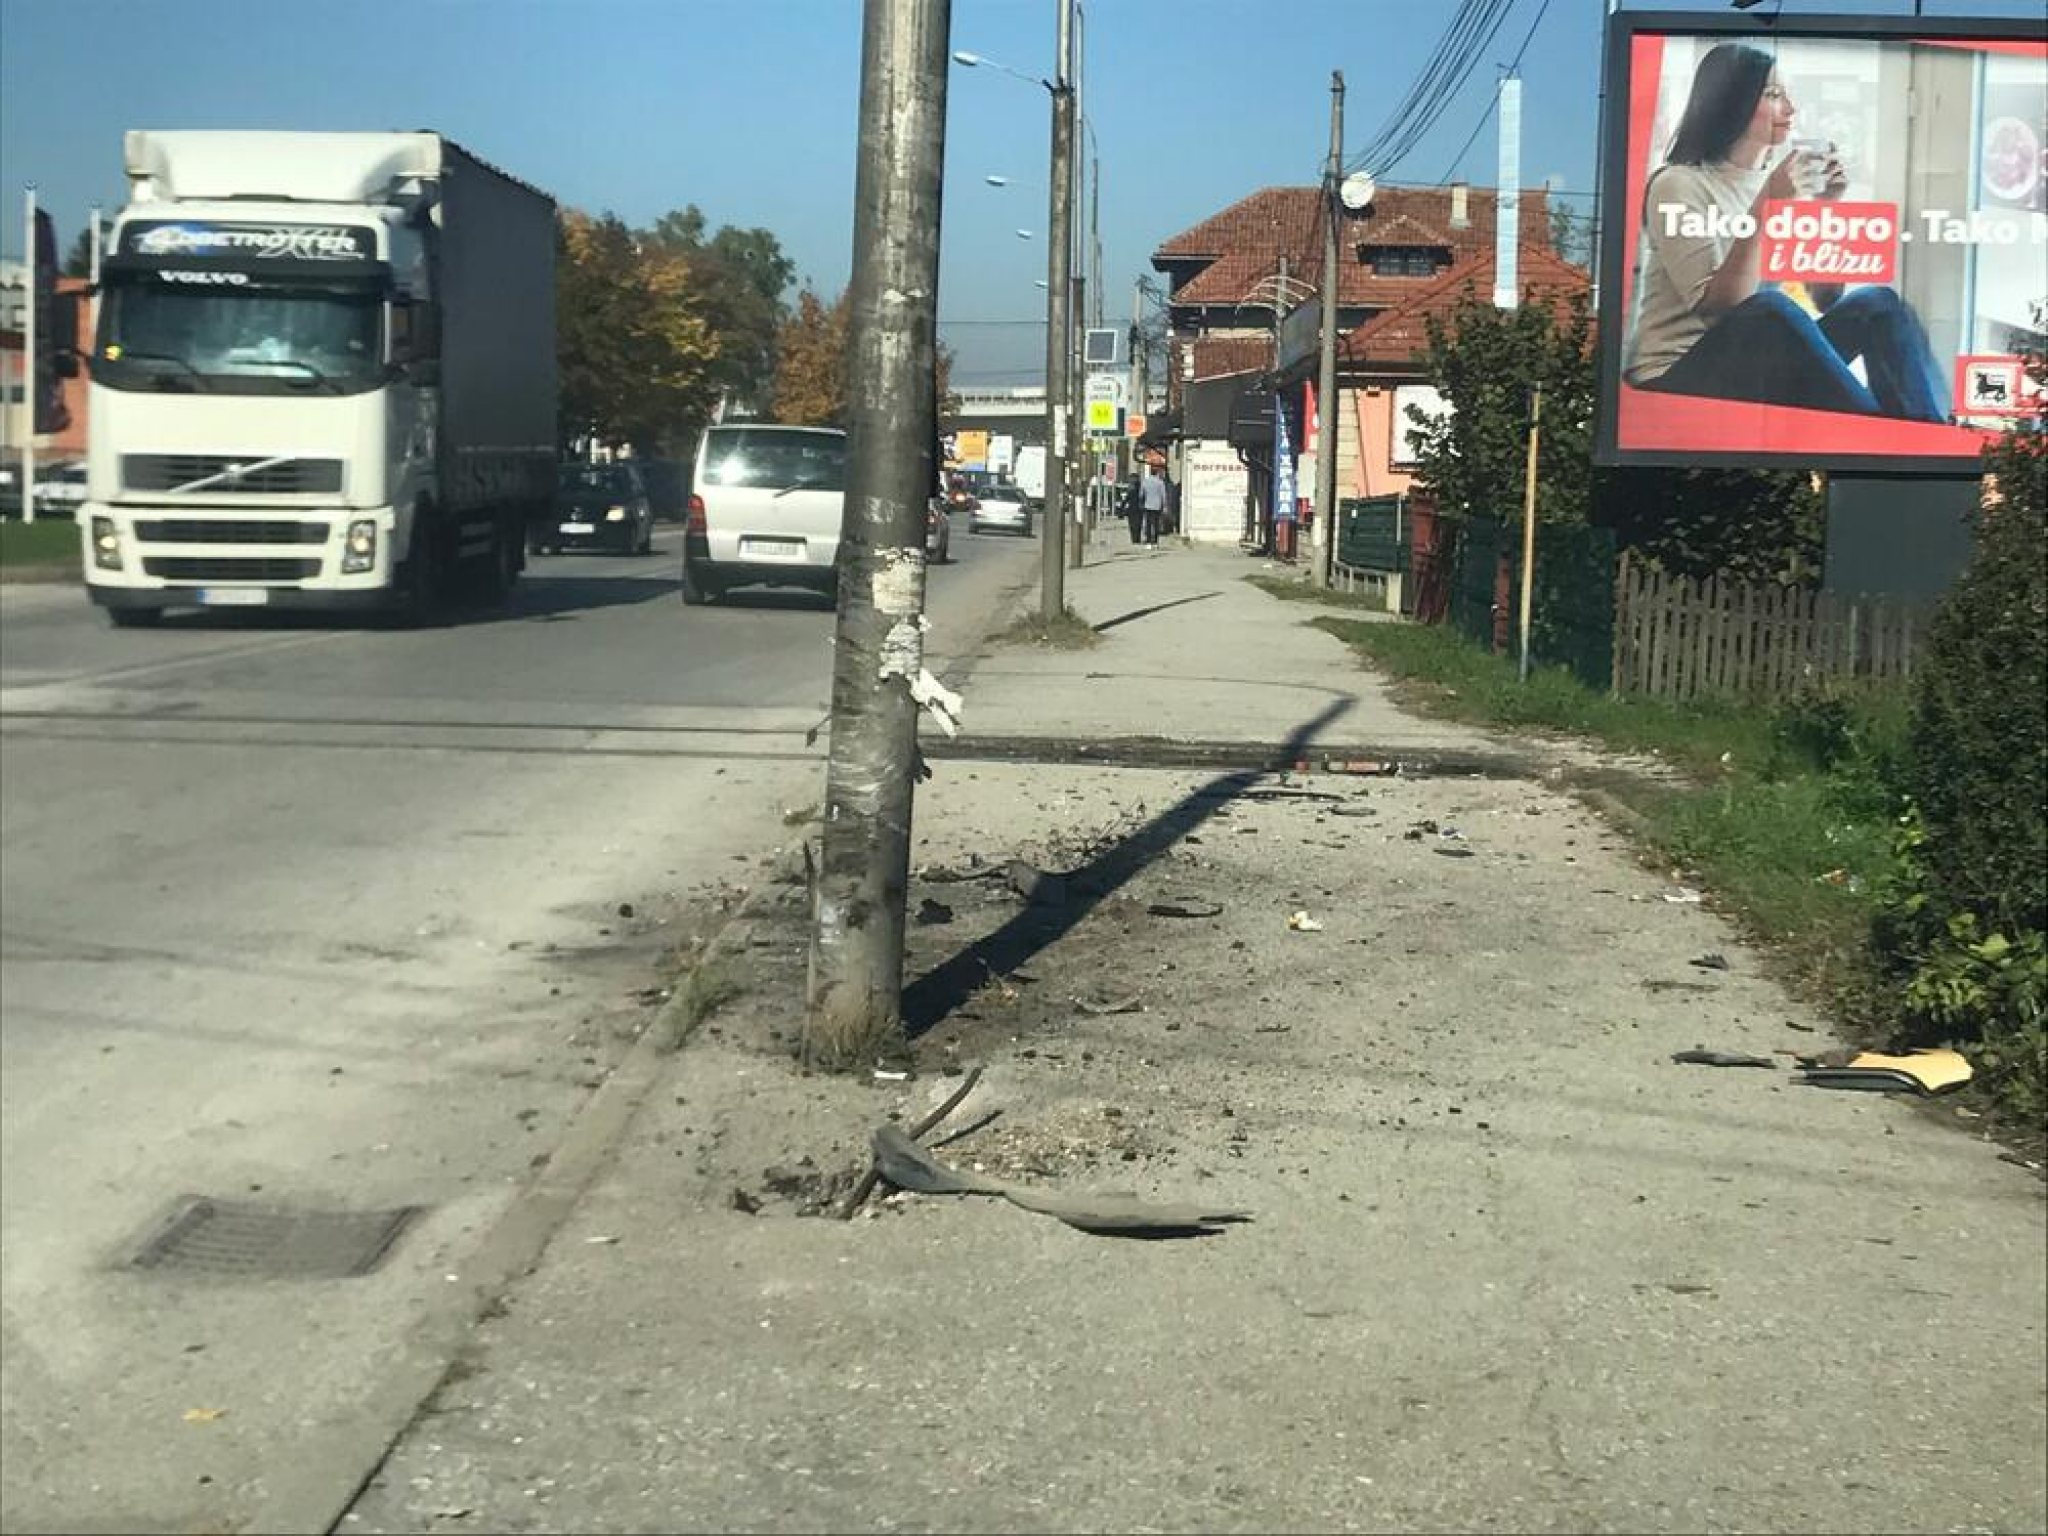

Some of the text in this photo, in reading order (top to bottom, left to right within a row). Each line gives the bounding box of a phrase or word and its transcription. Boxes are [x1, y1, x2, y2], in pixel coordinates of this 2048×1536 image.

[1658, 204, 1757, 239] Tako
[1921, 210, 2019, 244] Tako
[1769, 242, 1885, 274] i blizu
[158, 269, 248, 285] VOLVO
